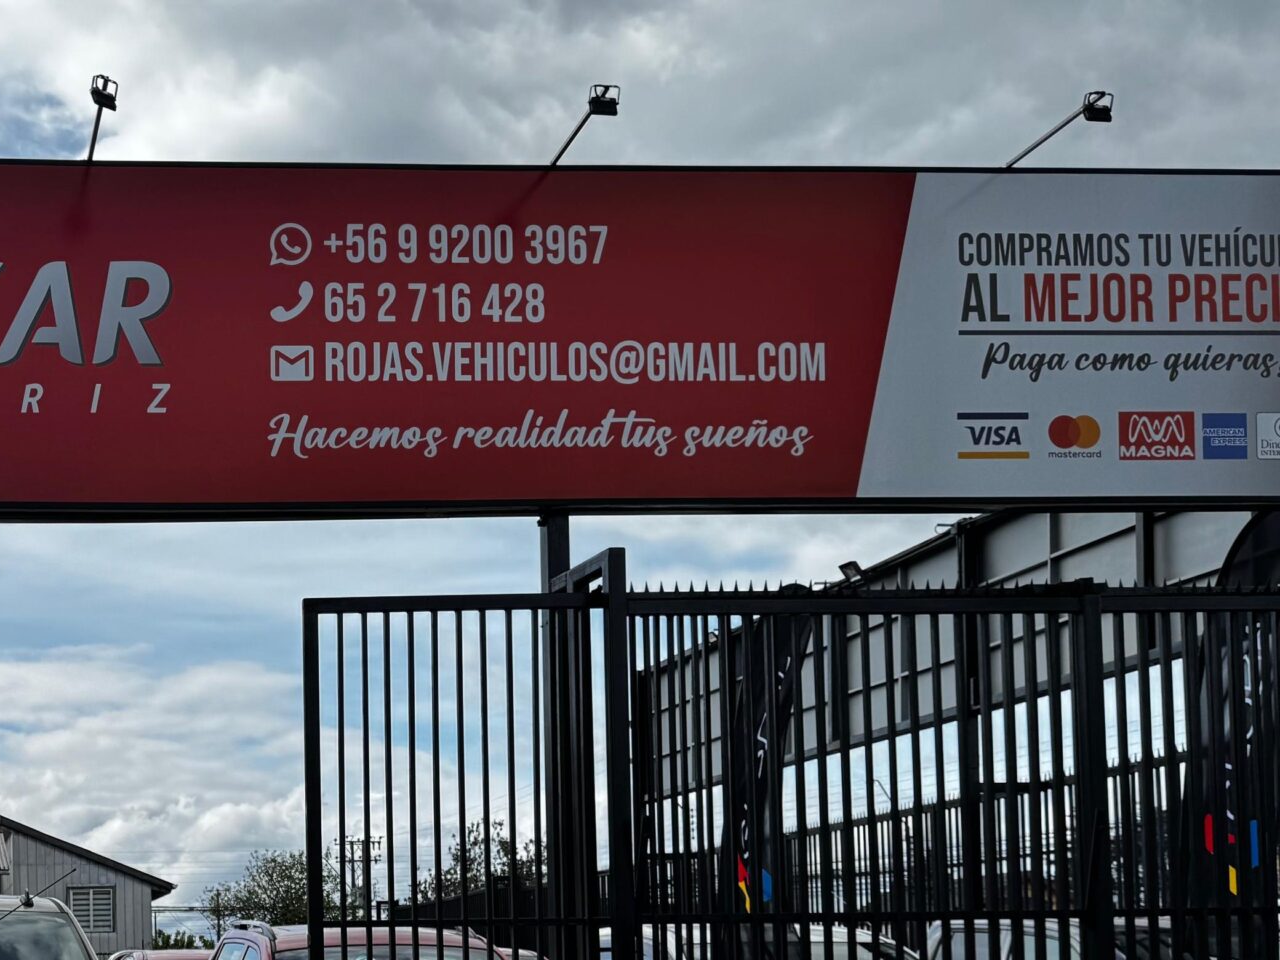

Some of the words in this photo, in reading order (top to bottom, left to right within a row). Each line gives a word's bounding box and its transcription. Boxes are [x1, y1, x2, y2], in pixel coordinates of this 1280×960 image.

[324, 223, 387, 264] +56
[397, 223, 418, 264] 9
[428, 223, 514, 265] 9200
[524, 224, 608, 265] 3967
[958, 232, 1131, 267] COMPRAMOS
[1137, 233, 1172, 267] TU
[1180, 226, 1280, 268] VEHÍCU
[324, 281, 366, 323] 65
[377, 281, 397, 323] 2
[407, 282, 471, 323] 716
[481, 282, 545, 323] 428
[960, 272, 1011, 323] AL
[1023, 272, 1154, 323] MEJOR
[325, 339, 826, 385] ROJAS.VEHICULOS@GMAIL.COM
[981, 341, 1070, 382] Paga
[1074, 352, 1158, 372] como
[267, 413, 448, 458] Hacemos
[452, 408, 614, 450] realidad
[606, 410, 677, 457] tus
[683, 418, 814, 457] sueños
[965, 425, 1022, 446] VISA
[1119, 444, 1195, 458] MAGNA
[1202, 427, 1245, 436] AMERICAN
[1210, 437, 1248, 446] EXPRESS
[1047, 450, 1102, 459] mastercard
